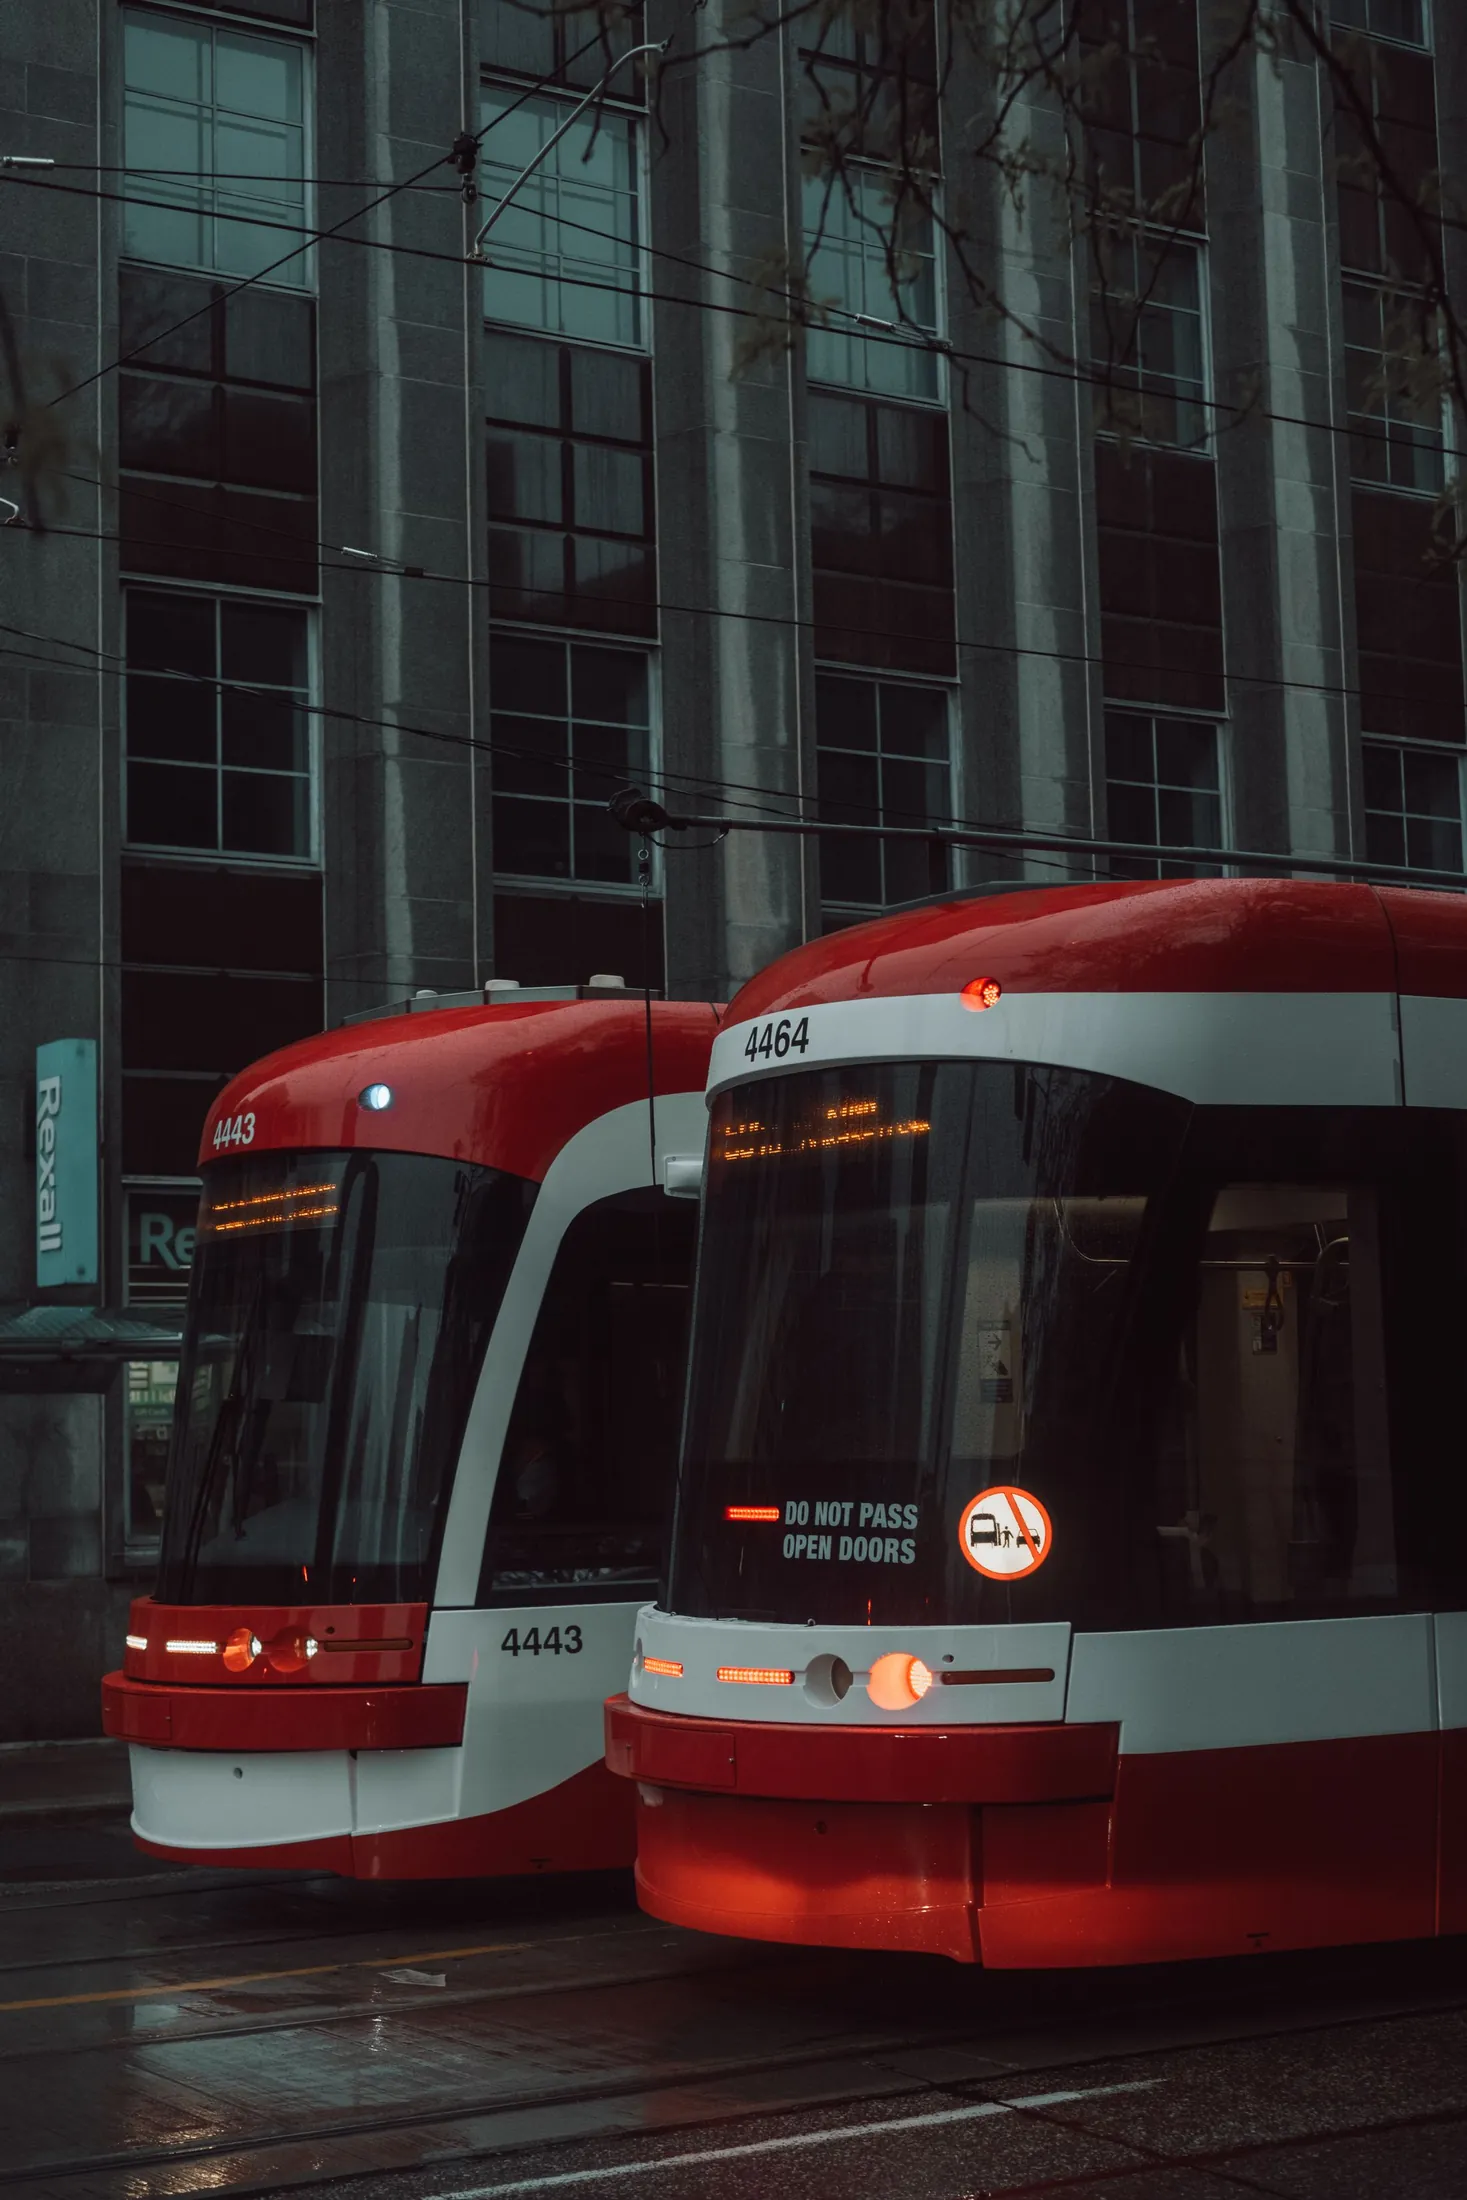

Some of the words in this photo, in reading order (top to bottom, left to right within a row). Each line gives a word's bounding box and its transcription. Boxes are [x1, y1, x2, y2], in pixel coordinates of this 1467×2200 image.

[744, 1017, 810, 1062] 4464
[213, 1112, 256, 1150] 4443
[38, 1075, 62, 1251] Rexall
[785, 1500, 809, 1527] DO
[815, 1501, 854, 1528] NOT
[860, 1502, 918, 1530] PASS
[783, 1533, 831, 1561] OPEN
[839, 1536, 916, 1565] DOORS
[501, 1625, 583, 1657] 4443
